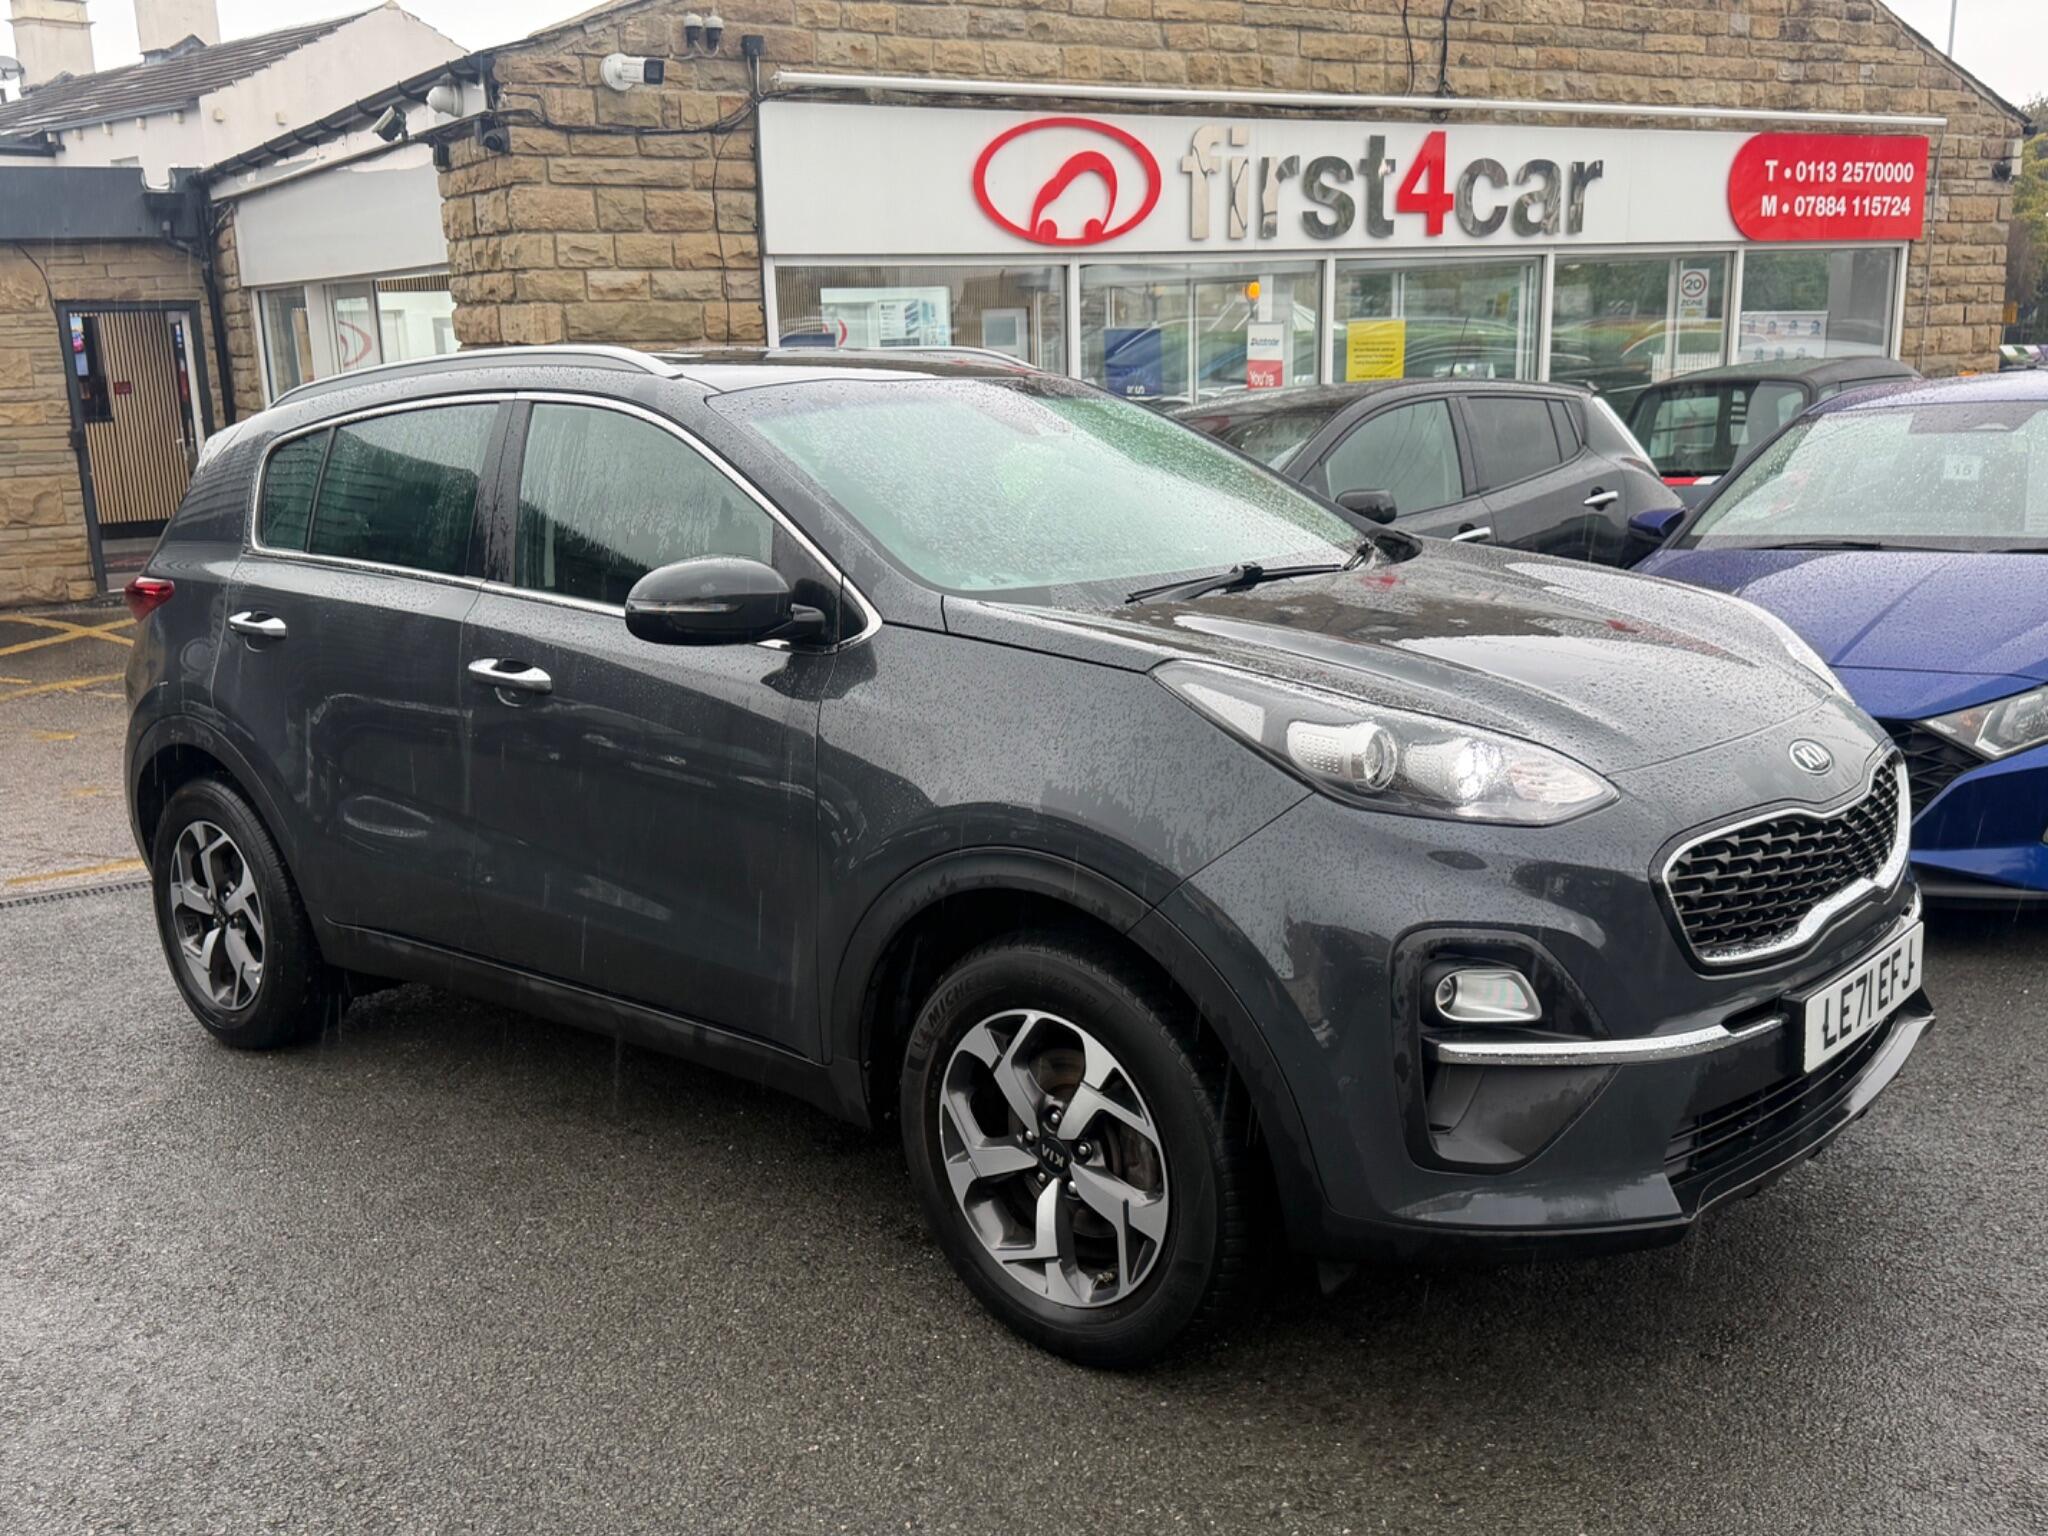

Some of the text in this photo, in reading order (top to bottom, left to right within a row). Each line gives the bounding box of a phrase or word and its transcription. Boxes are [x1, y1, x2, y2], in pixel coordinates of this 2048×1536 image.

[1180, 125, 1603, 239] first4car
[1765, 160, 1914, 183] T 0113 2570000
[1761, 195, 1911, 217] M 07884 115724
[1684, 279, 1702, 291] 20
[1249, 369, 1275, 387] You're
[1041, 1143, 1065, 1168] KIA
